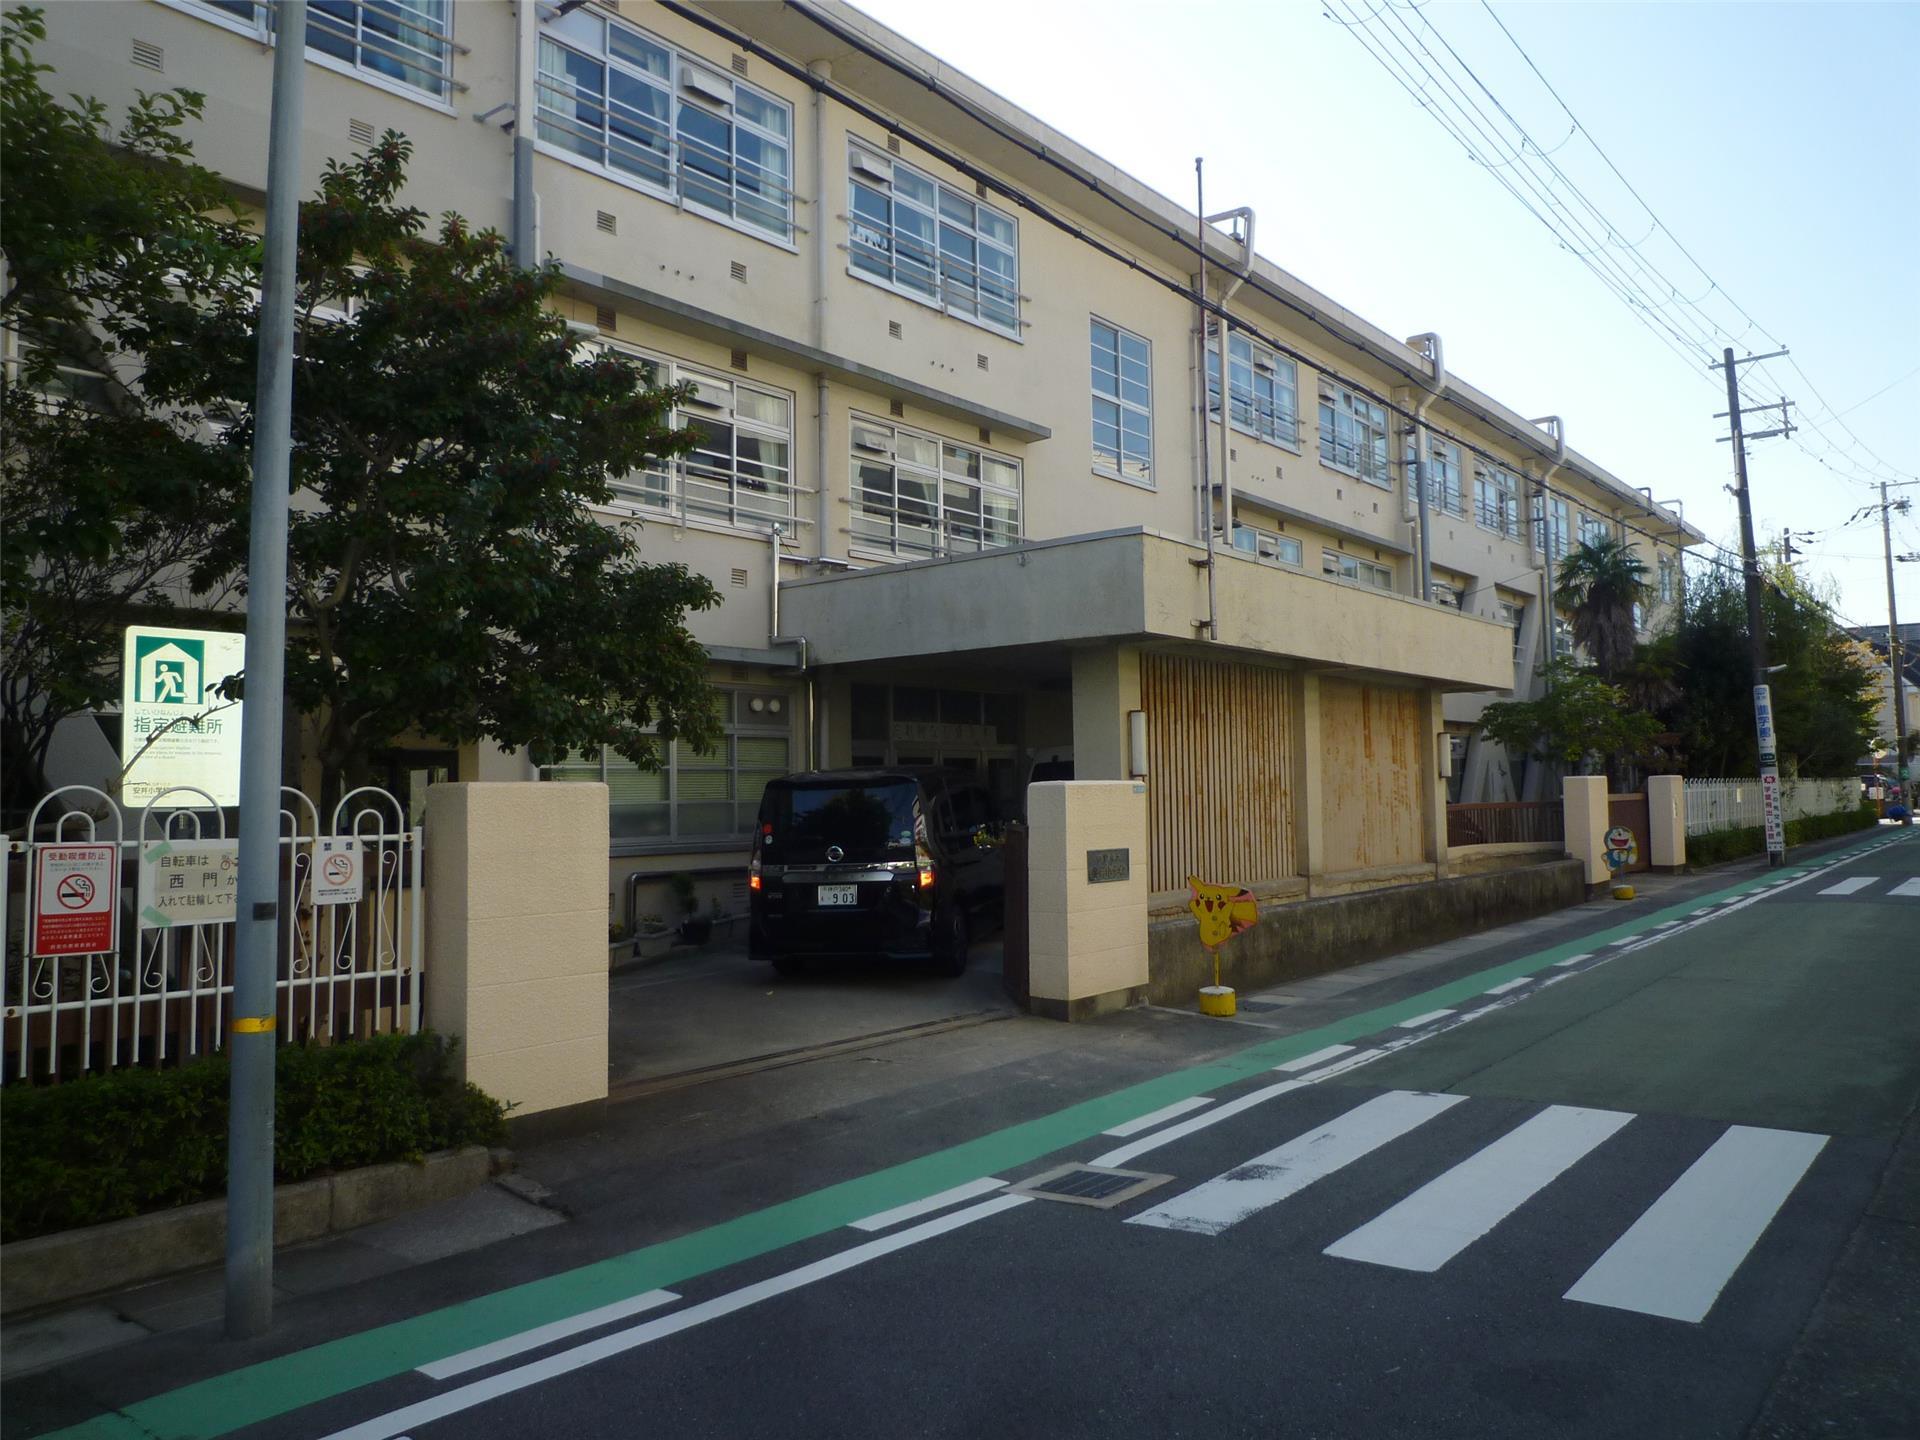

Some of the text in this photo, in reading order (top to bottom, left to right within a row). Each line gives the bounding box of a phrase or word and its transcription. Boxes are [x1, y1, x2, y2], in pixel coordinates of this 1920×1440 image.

[134, 716, 223, 735] 指定避難所
[323, 841, 353, 851] 禁煙
[48, 851, 106, 861] 受動喫煙防止
[160, 855, 209, 868] 自転車は
[832, 892, 855, 904] 903
